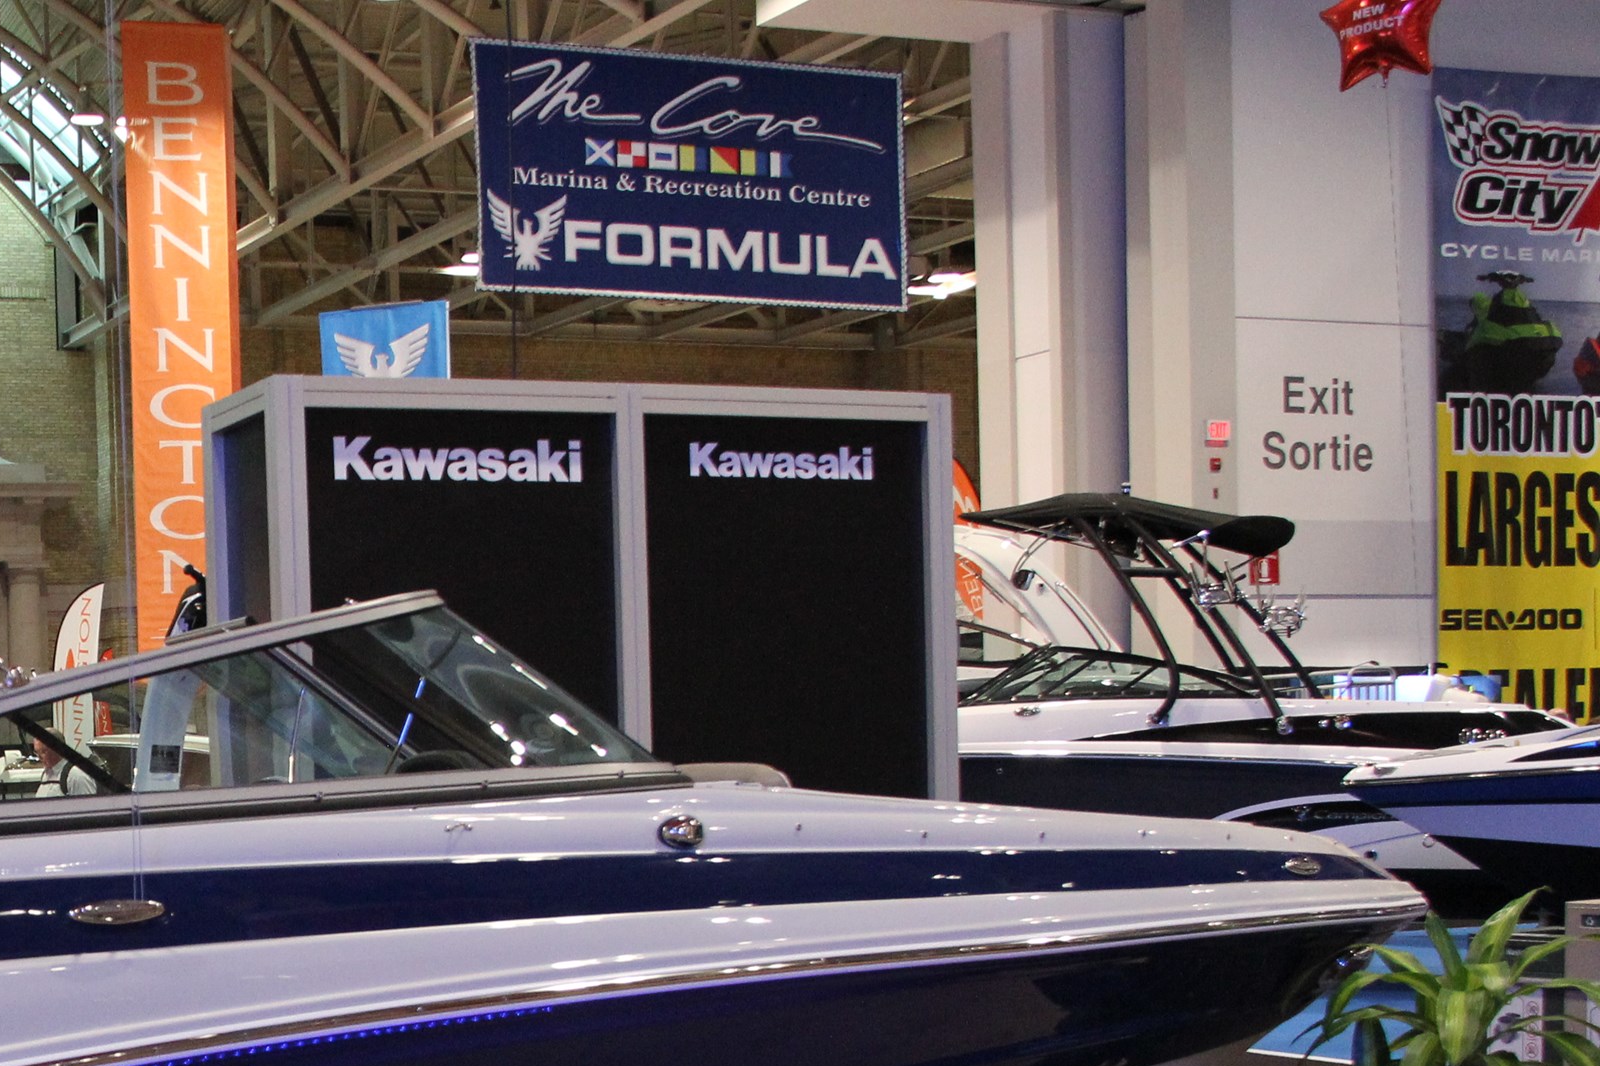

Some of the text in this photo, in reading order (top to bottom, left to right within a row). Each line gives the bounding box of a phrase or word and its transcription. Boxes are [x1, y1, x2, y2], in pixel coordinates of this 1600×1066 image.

[1340, 15, 1404, 40] PRODUCT
[1352, 3, 1386, 20] NEW
[505, 58, 884, 151] The Cove
[1482, 120, 1600, 166] Snow
[513, 166, 871, 209] Marina & Recreation Centre
[1460, 175, 1584, 225] City
[563, 219, 898, 281] FORMULA
[1441, 243, 1534, 262] CYCLE
[1283, 375, 1354, 416] Exit
[1208, 421, 1228, 439] EXIT
[1262, 430, 1373, 473] Sortie
[333, 436, 583, 484] Kawasaki
[689, 441, 874, 481] Kawasaki
